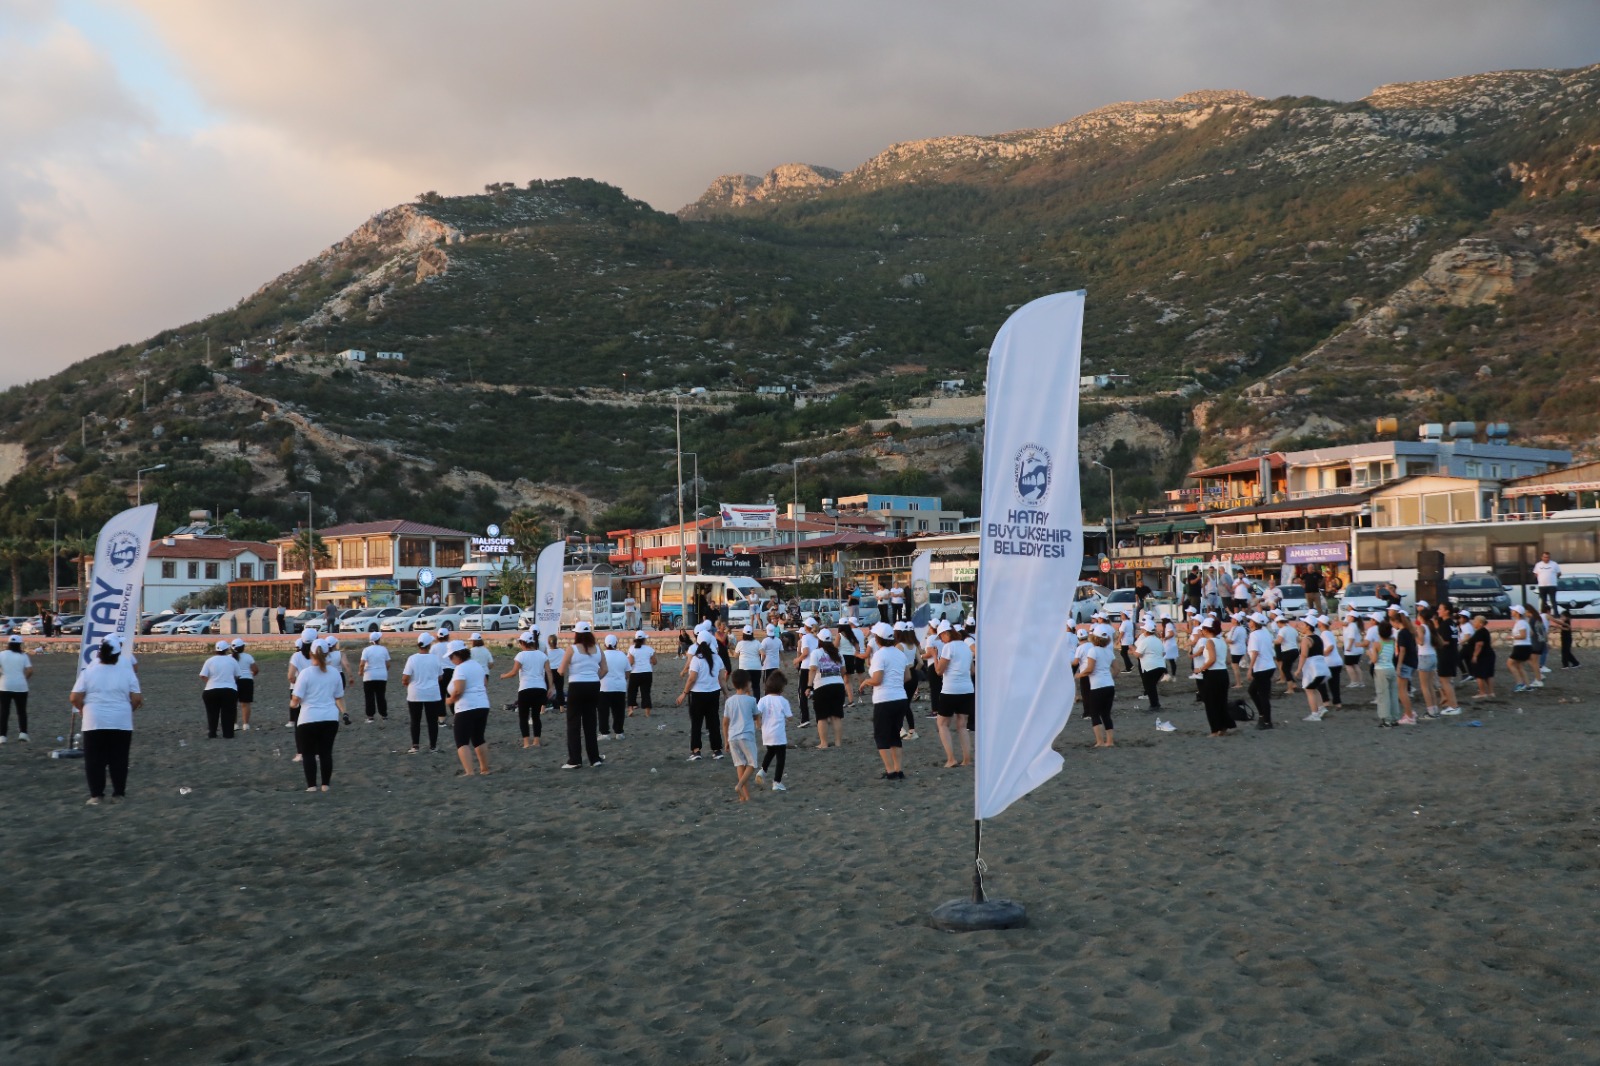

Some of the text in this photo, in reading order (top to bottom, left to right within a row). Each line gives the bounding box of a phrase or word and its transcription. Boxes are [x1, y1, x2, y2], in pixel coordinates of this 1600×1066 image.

[1008, 509, 1049, 525] HATAY
[988, 523, 1072, 542] BÜYÜKŞEHİR
[994, 540, 1065, 558] BELEDİYESİ
[1320, 547, 1342, 556] TEKEL
